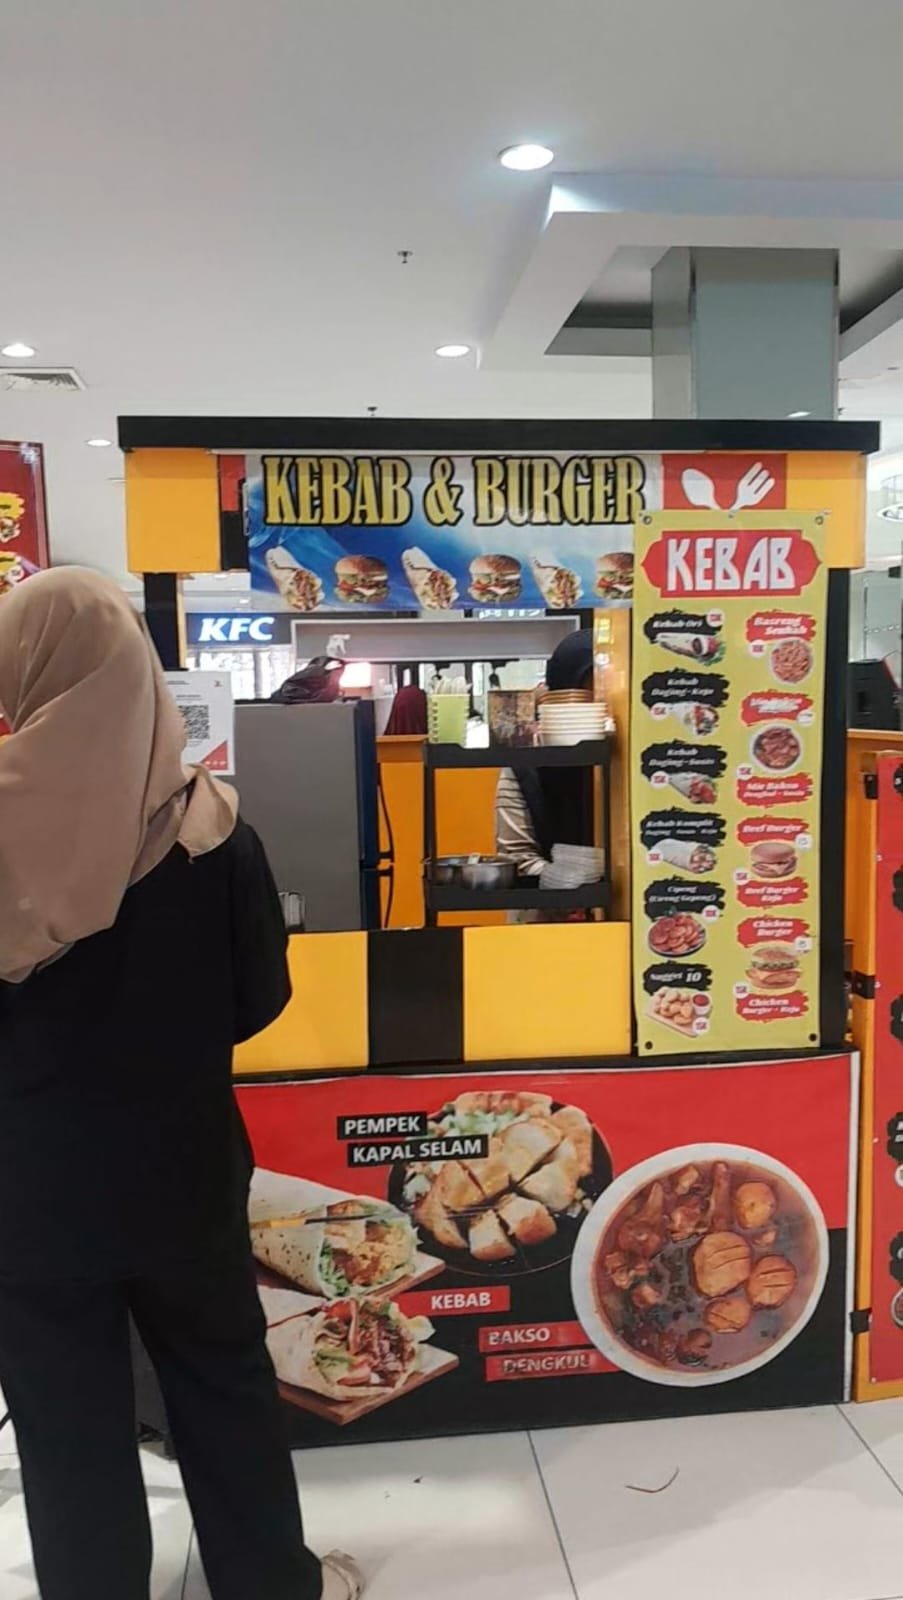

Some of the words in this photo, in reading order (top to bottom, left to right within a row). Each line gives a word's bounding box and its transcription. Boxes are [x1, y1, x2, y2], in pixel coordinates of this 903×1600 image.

[262, 456, 410, 524] KEBAB
[423, 456, 463, 525] &
[472, 456, 646, 524] BURGER
[667, 537, 796, 591] KEBAB
[198, 616, 275, 642] KFC
[653, 620, 685, 629] Kebab
[667, 678, 699, 687] Kebab
[667, 748, 699, 757] Kebab
[646, 820, 675, 828] Kebab
[742, 825, 765, 833] Beef
[766, 824, 803, 834] Burger
[745, 886, 766, 895] Beef
[766, 886, 800, 895] Burger
[752, 920, 793, 929] Chicken
[756, 928, 793, 938] Burger
[686, 972, 702, 982] 10
[748, 998, 789, 1007] Chicken
[344, 1115, 421, 1135] PEMPEK
[353, 1143, 415, 1163] KAPAL
[419, 1138, 482, 1157] SELAM
[431, 1292, 491, 1310] KEBAB
[489, 1327, 551, 1346] BAKSO
[503, 1355, 591, 1374] DENGKUL
